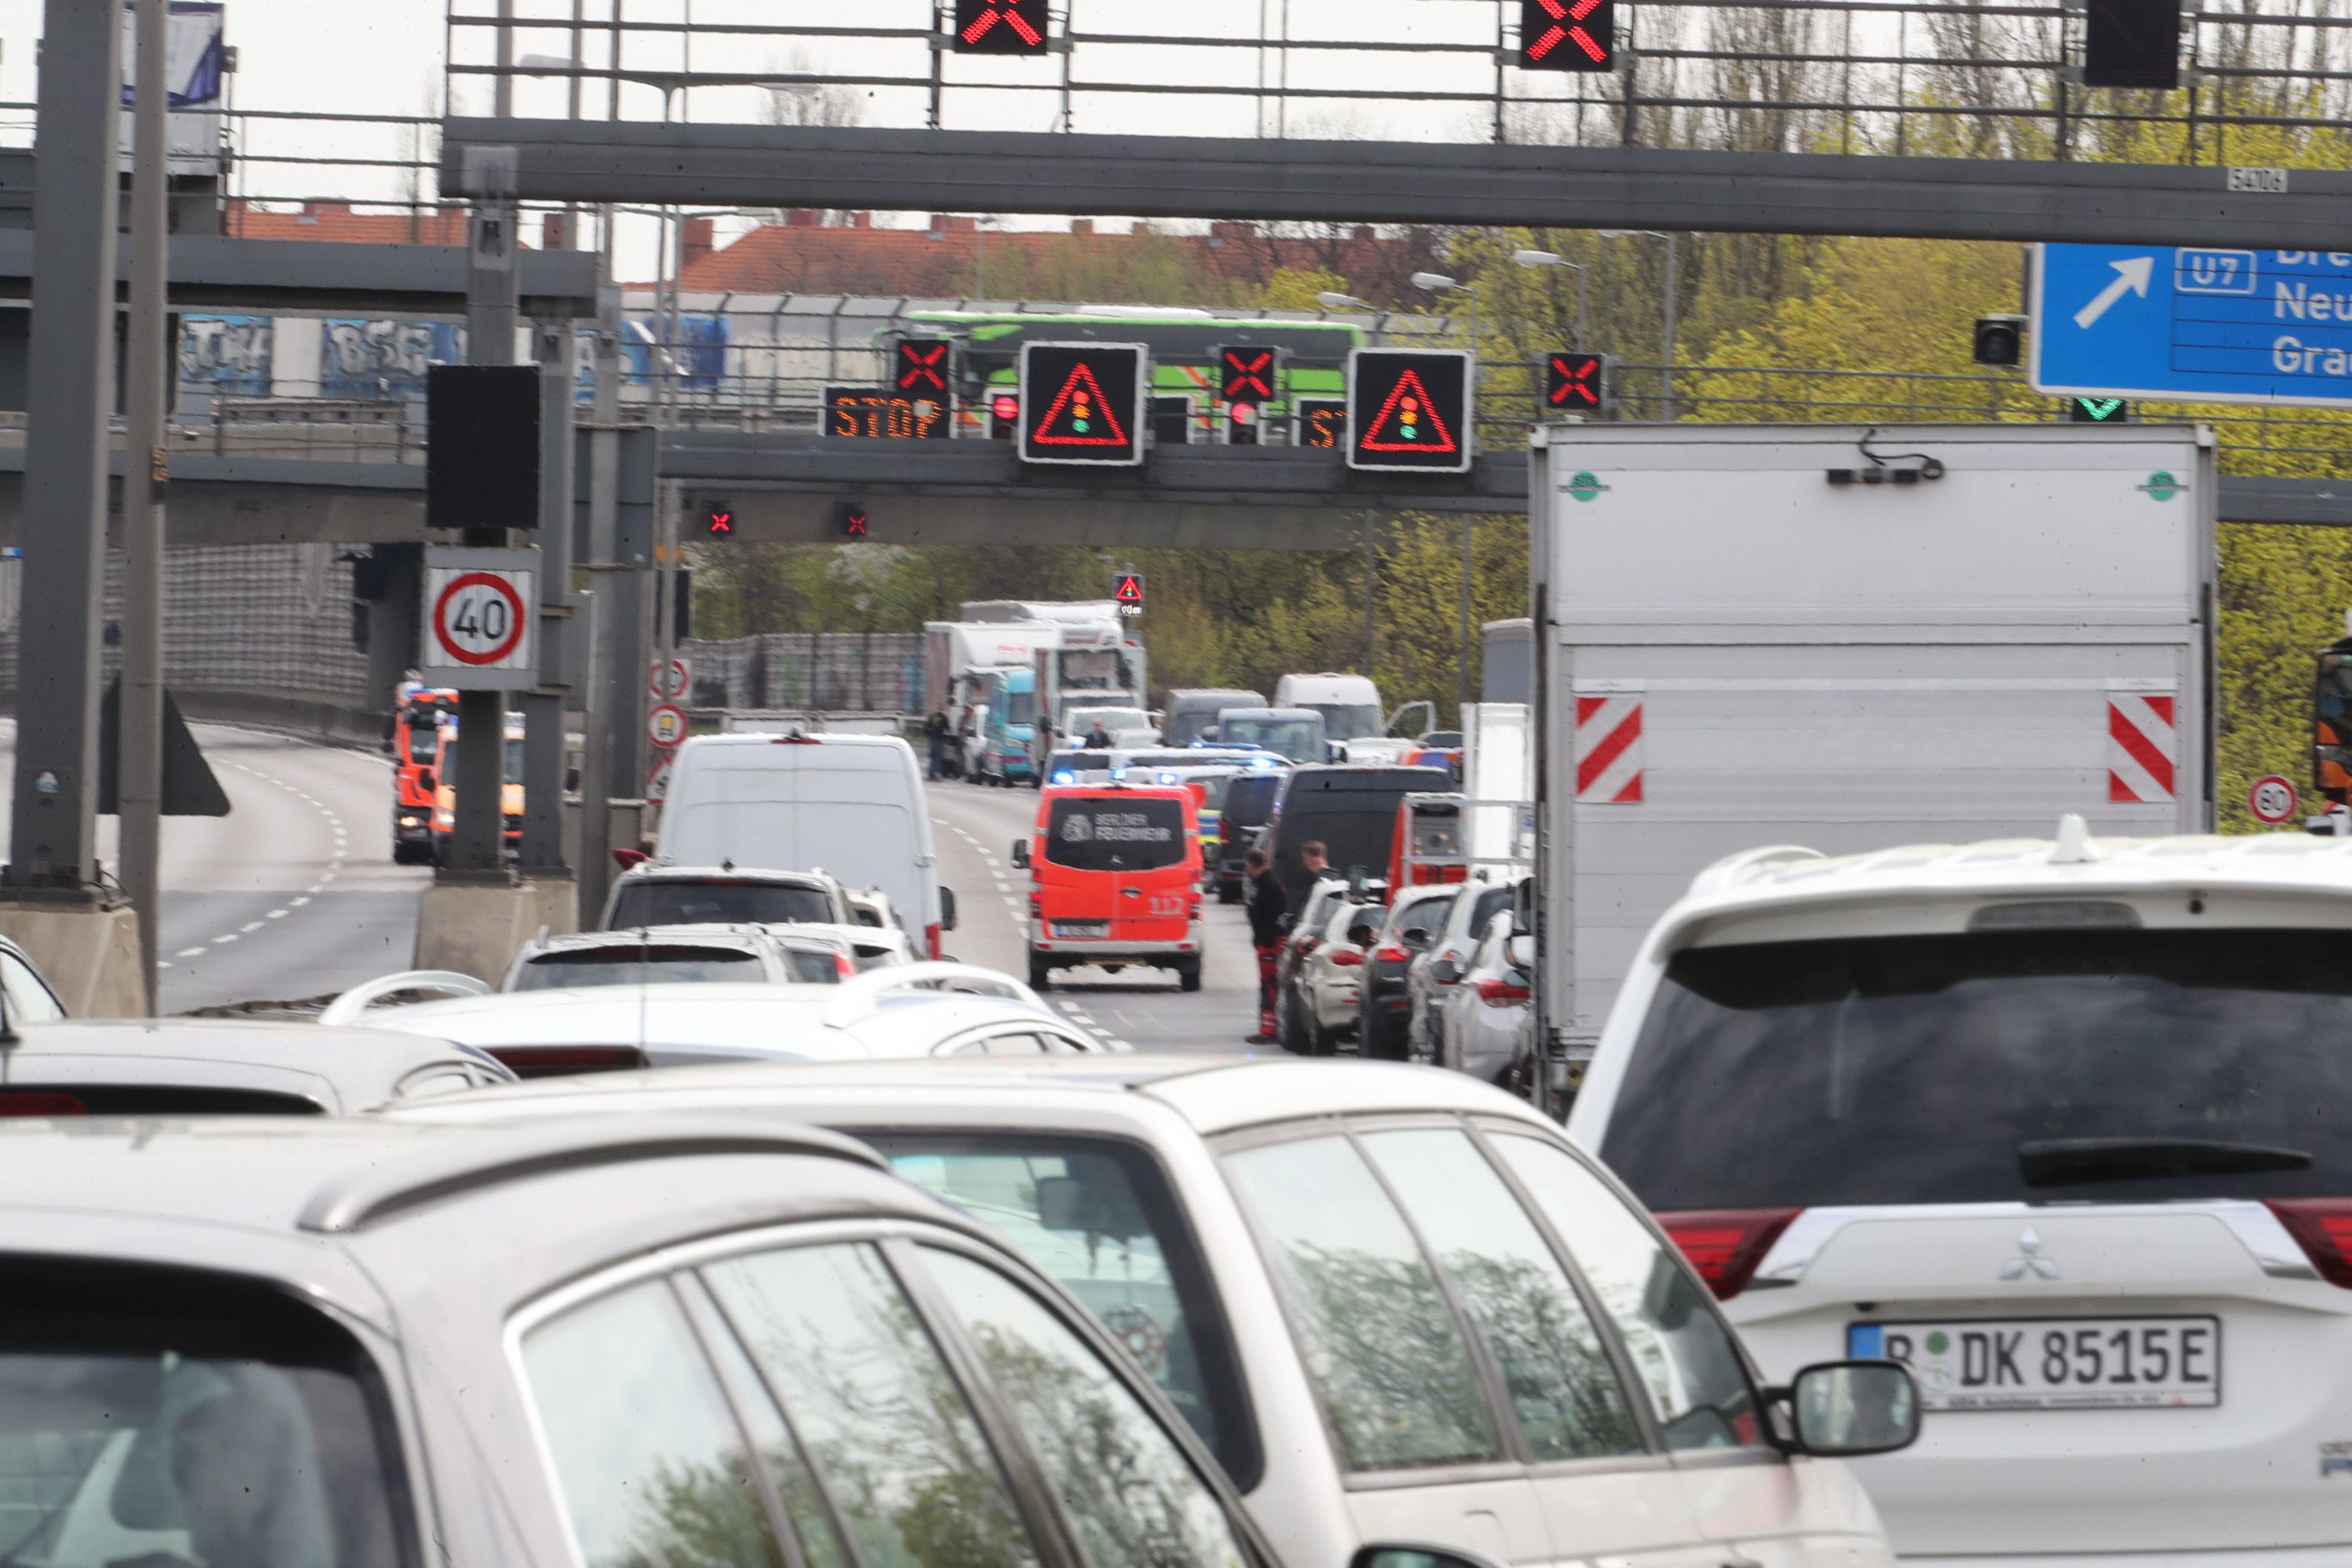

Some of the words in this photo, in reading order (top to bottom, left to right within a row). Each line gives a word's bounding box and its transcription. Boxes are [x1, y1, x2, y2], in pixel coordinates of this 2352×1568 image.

[2193, 255, 2239, 285] U7
[2273, 335, 2352, 375] Gra
[836, 396, 942, 438] STOP
[452, 597, 505, 640] 40
[1148, 896, 1184, 916] 112
[1961, 1331, 2024, 1387] DK
[2043, 1327, 2209, 1385] 8515E
